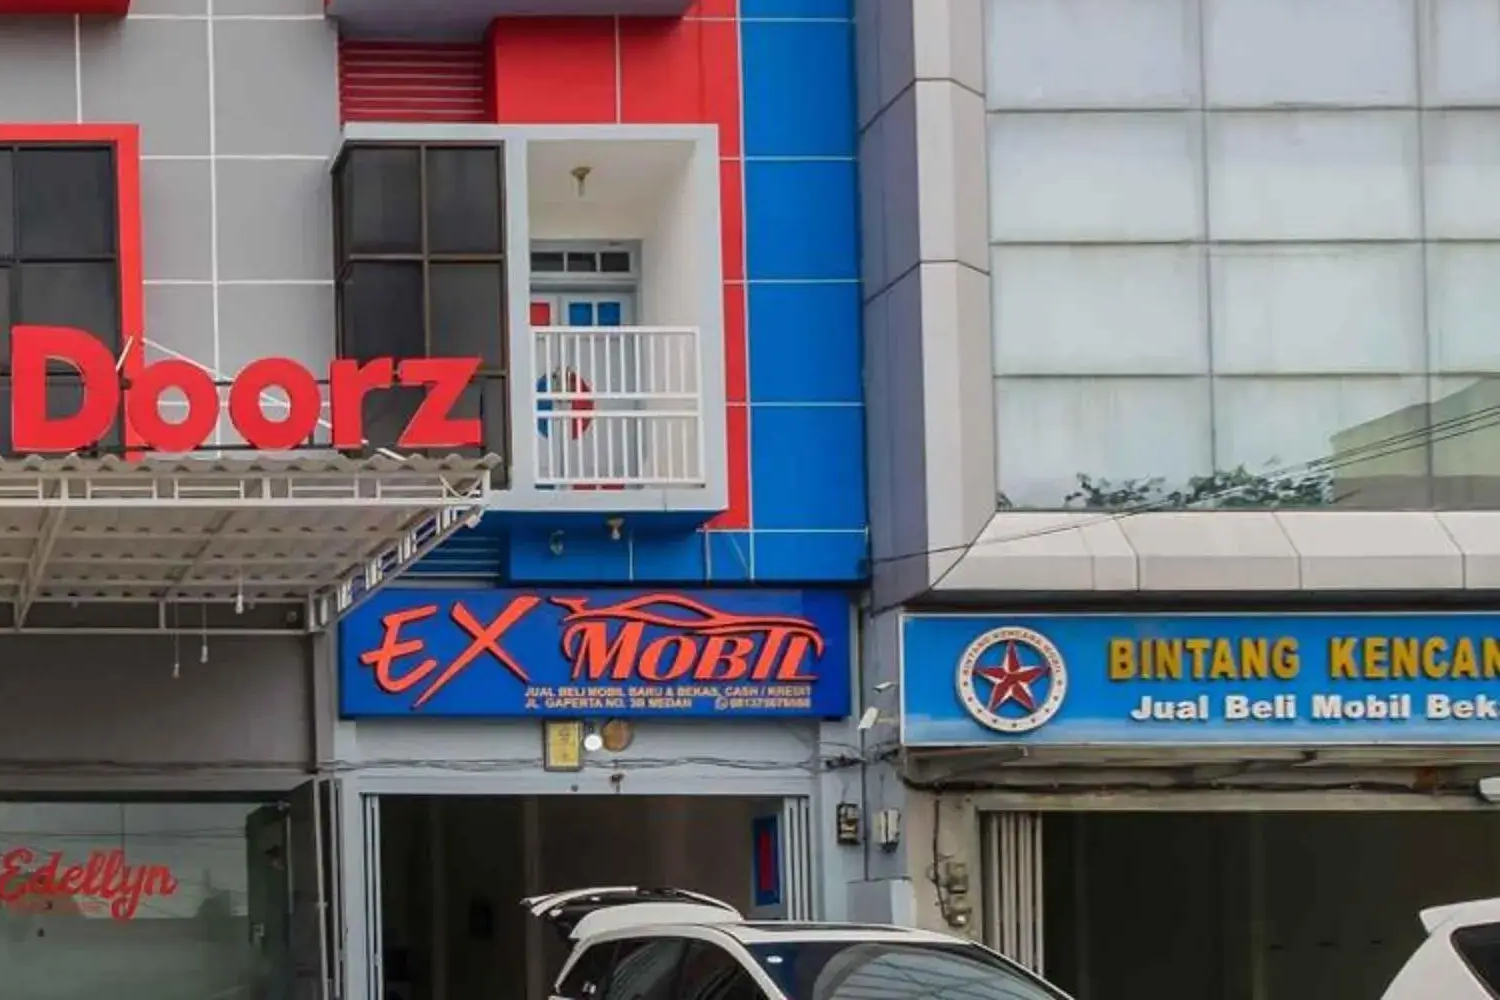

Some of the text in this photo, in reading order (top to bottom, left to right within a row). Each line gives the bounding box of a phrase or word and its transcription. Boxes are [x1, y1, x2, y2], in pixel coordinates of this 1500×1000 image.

[360, 595, 540, 708] EX
[1109, 638, 1299, 680] BINTANG
[1132, 694, 1208, 719] Jual
[1225, 694, 1296, 719] Beli
[1312, 693, 1411, 719] Mobil
